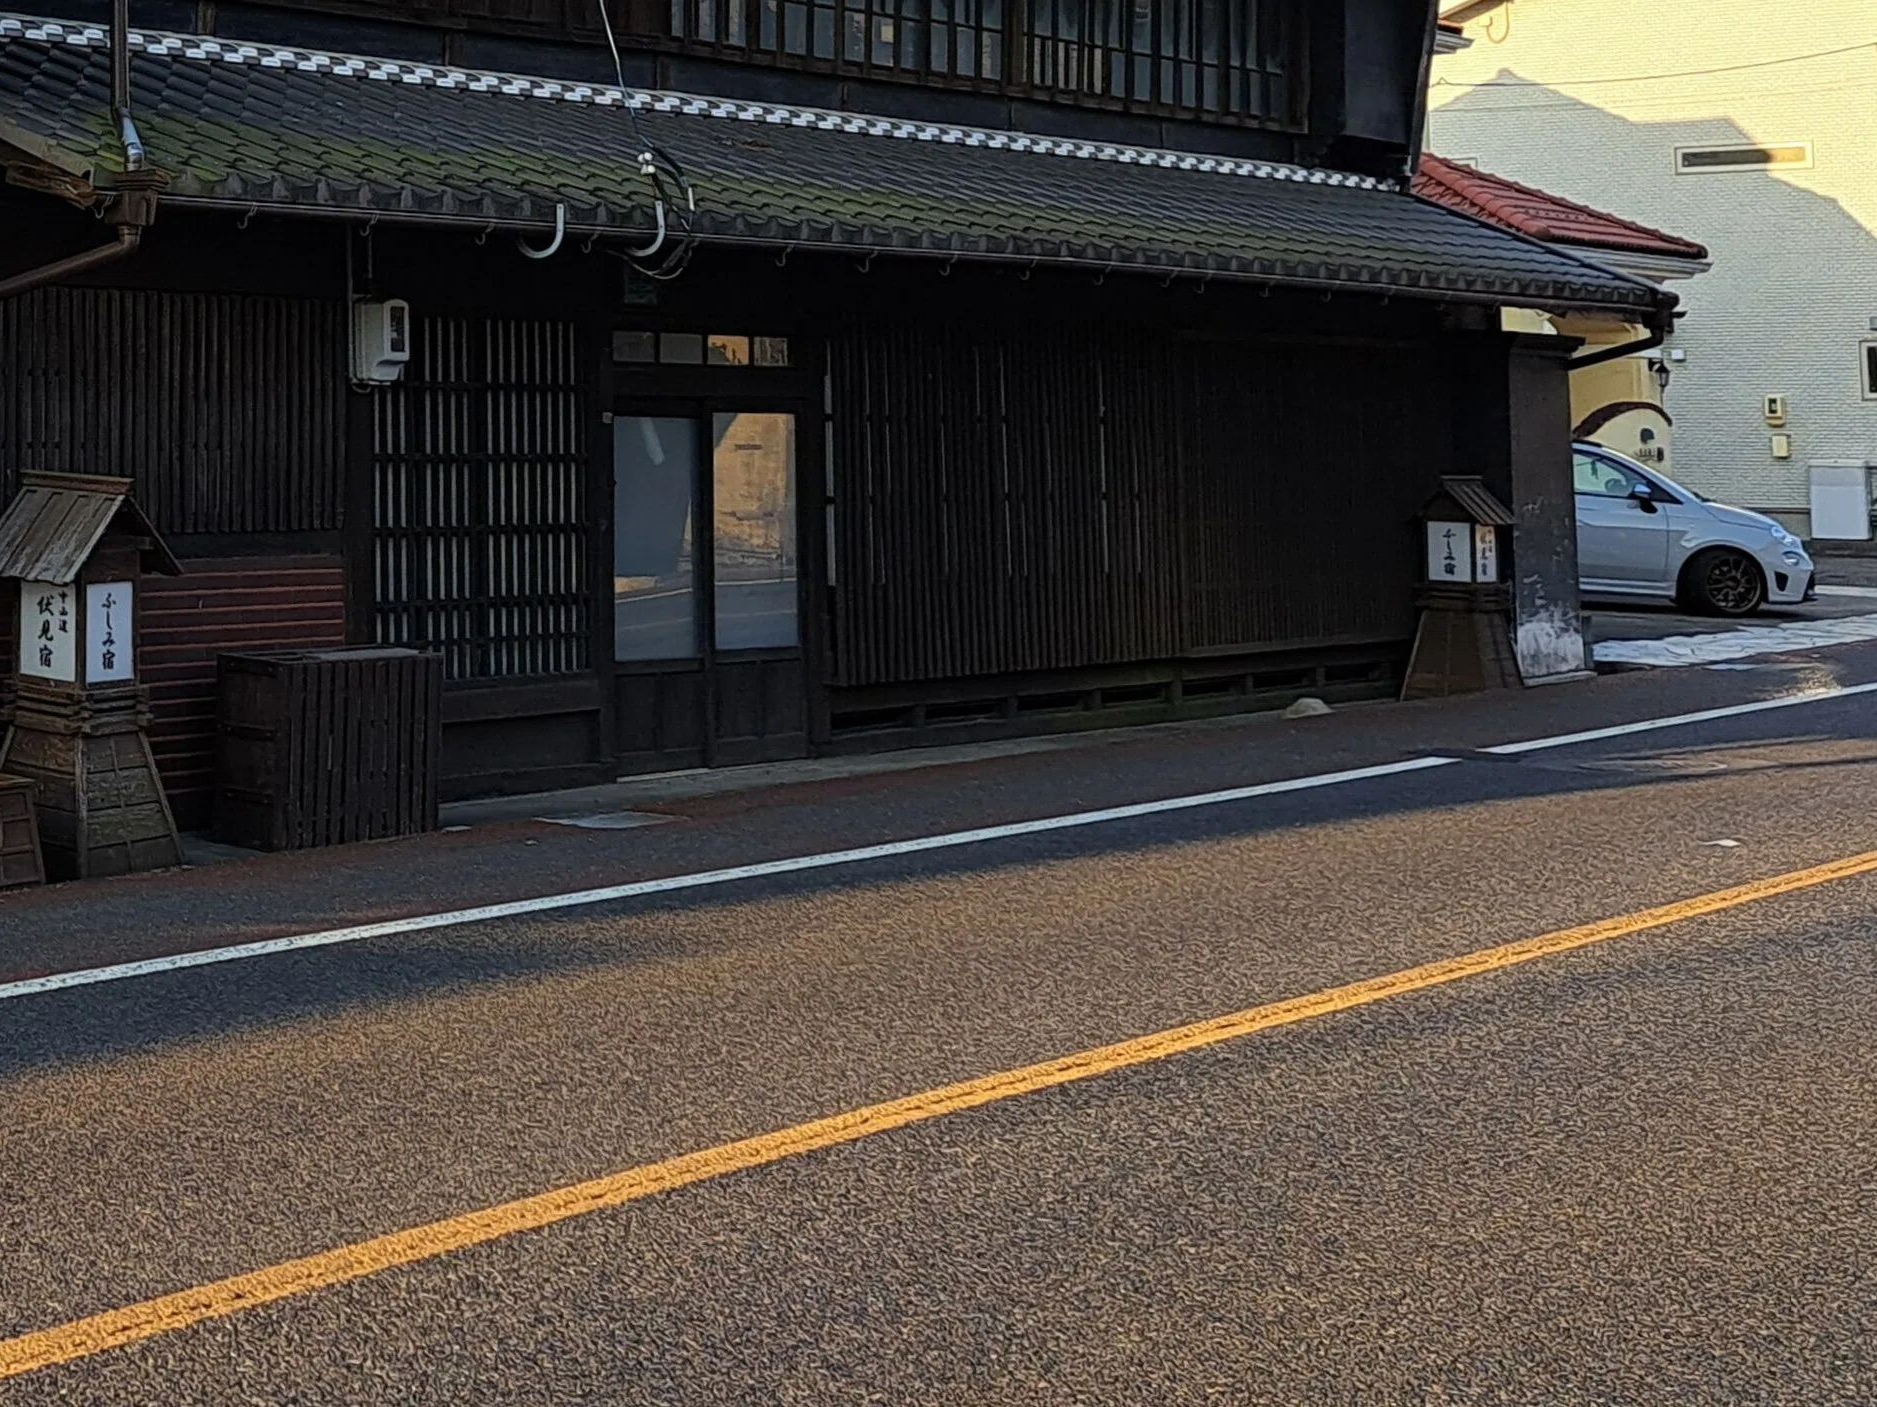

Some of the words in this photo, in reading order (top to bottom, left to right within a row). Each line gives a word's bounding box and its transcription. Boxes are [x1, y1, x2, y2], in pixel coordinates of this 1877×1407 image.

[36, 595, 54, 668] 伏見宿
[58, 591, 68, 633] 中山道
[102, 593, 116, 670] ふしみ宿
